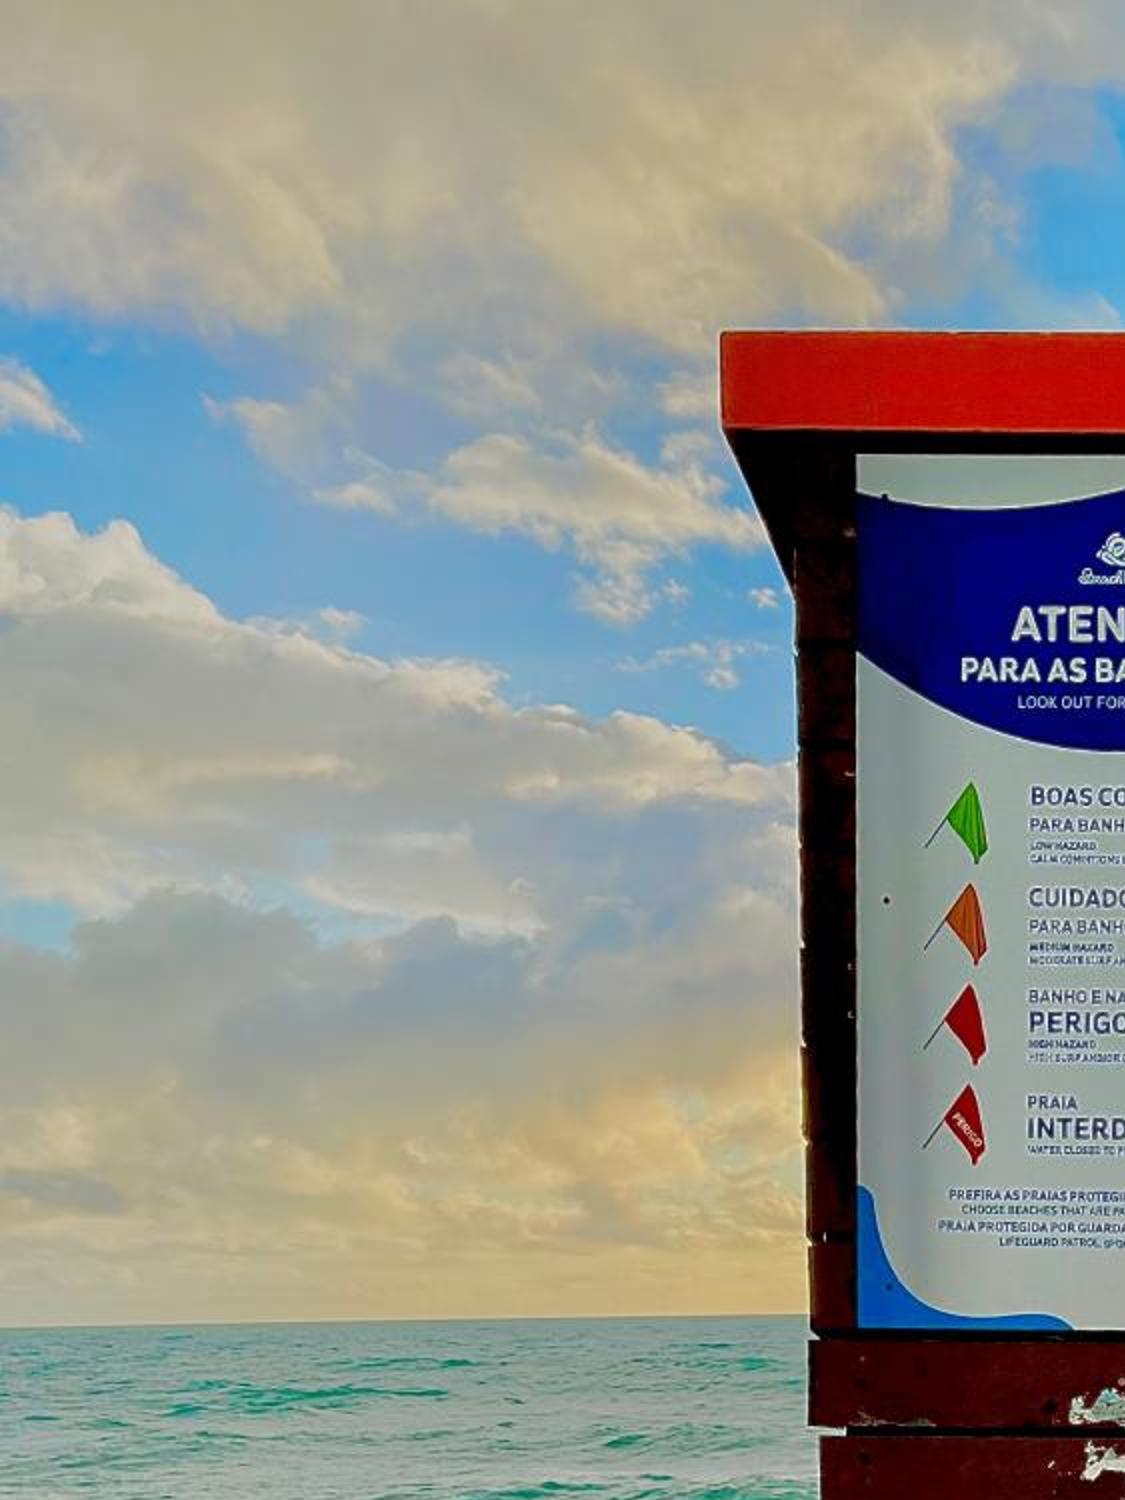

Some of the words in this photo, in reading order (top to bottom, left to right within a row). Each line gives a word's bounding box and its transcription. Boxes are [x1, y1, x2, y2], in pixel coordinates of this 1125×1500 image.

[960, 656, 1041, 684] PARA
[1047, 657, 1087, 684] AS
[1017, 694, 1057, 709] LOOK
[1062, 695, 1092, 710] OUT
[1031, 786, 1093, 806] BOAS
[1029, 817, 1073, 833] PARA
[1055, 841, 1096, 851] HAZARD
[1029, 919, 1072, 934] PARA
[1029, 990, 1087, 1003] BANHO
[1092, 990, 1101, 1004] E
[1056, 1040, 1096, 1049] HAZARD
[1028, 1095, 1077, 1110] PRAIA
[952, 1112, 983, 1148] PERIGO
[949, 1189, 1000, 1201] PREFIRA
[1004, 1190, 1020, 1201] AS
[1022, 1190, 1067, 1202] PRAIAS
[961, 1204, 1004, 1215] CHOOSE
[1008, 1205, 1057, 1216] BEACHES
[1061, 1206, 1087, 1216] THAT
[1090, 1206, 1111, 1217] ARE
[938, 1219, 976, 1232] PRAIA
[978, 1221, 1048, 1233] PROTEGIDA
[1050, 1222, 1076, 1233] POR
[1000, 1236, 1058, 1247] LIFEGUARD
